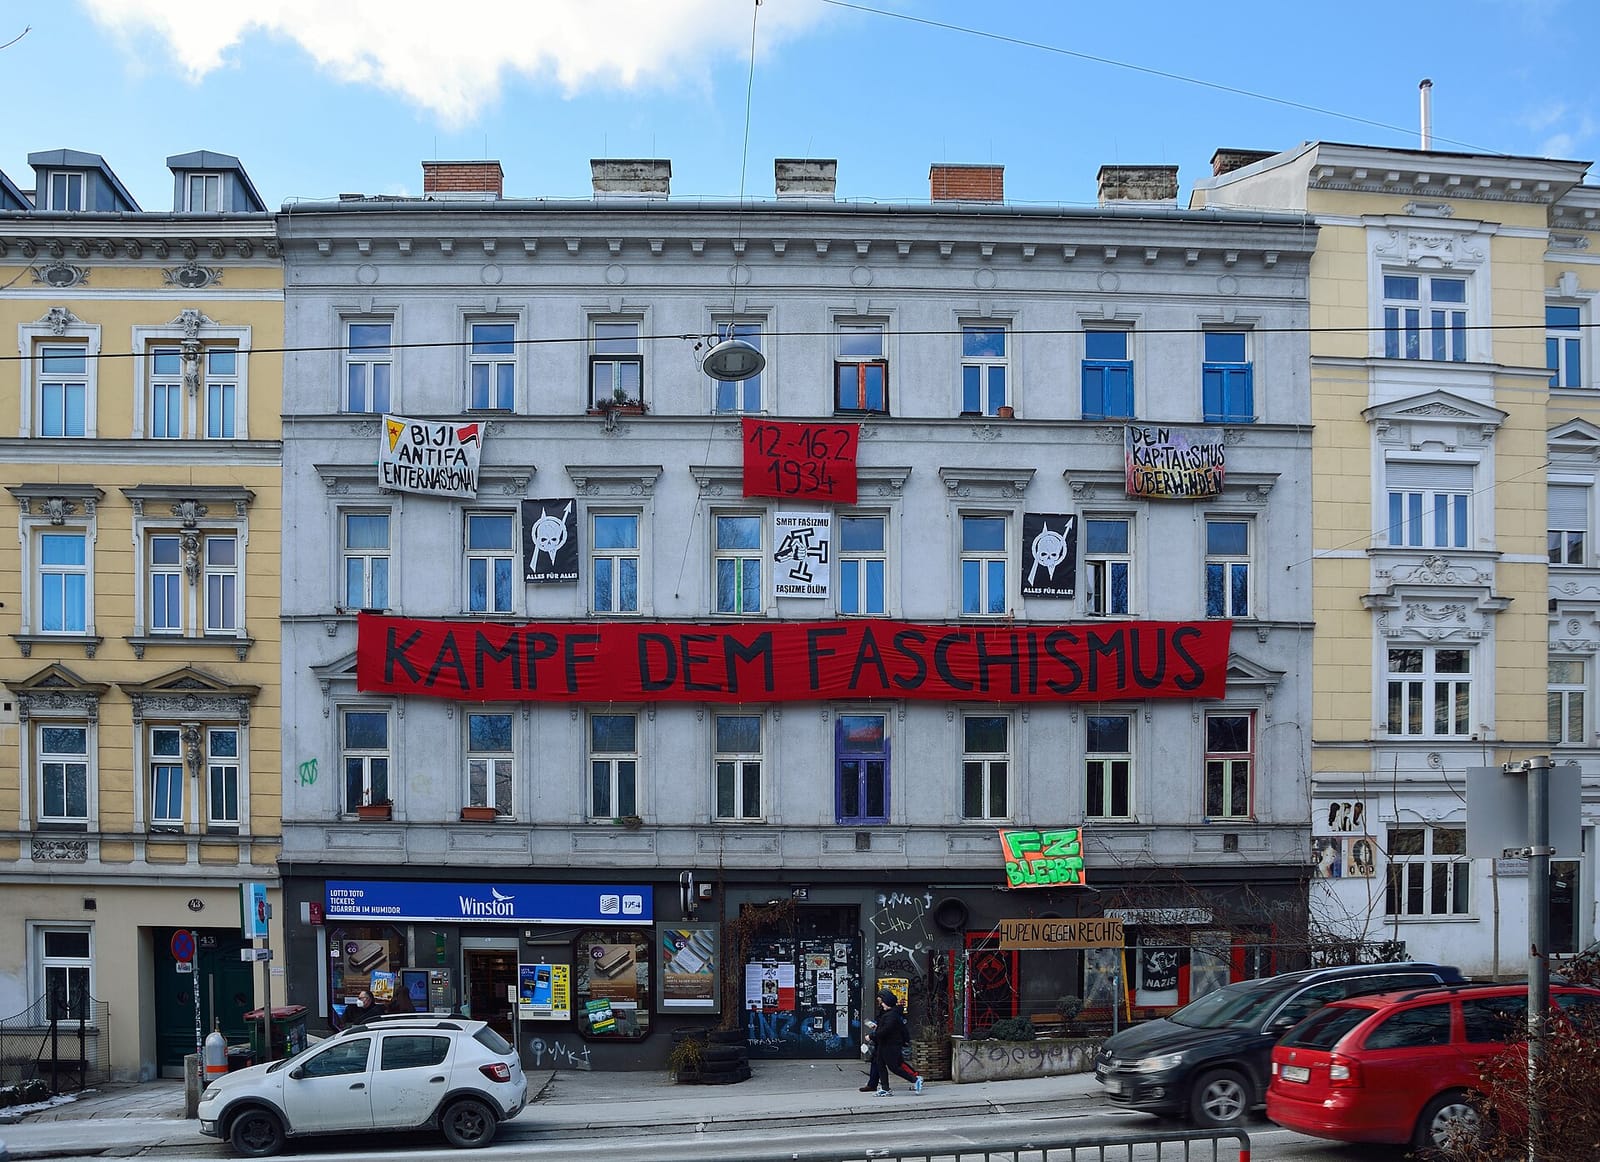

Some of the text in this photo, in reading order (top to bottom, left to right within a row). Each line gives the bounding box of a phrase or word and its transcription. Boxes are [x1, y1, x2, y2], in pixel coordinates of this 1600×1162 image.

[411, 425, 453, 446] BIJI
[1131, 427, 1169, 446] DEN
[399, 444, 468, 466] ANTIFA
[383, 462, 477, 492] ENTERNASYONAL
[768, 460, 837, 494] 1934
[776, 516, 829, 527] SMRT FAŠIZMU
[546, 571, 559, 579] FÜR
[807, 583, 827, 594] ÖLÜM
[1043, 586, 1056, 594] FÜR
[385, 626, 1205, 694] KAMPF DEM FASCHISMUS
[1004, 830, 1079, 858] FZ
[330, 889, 364, 898] LOTTO TOTO
[192, 900, 201, 908] 43
[330, 897, 355, 905] TICKETS
[458, 895, 514, 916] Winston
[330, 905, 361, 913] ZIGARREN
[371, 906, 401, 914] HUMIDOR
[1000, 922, 1124, 943] HUPEN GEGEN RECHTS
[200, 936, 215, 944] 43
[1146, 977, 1177, 988] NAZIS
